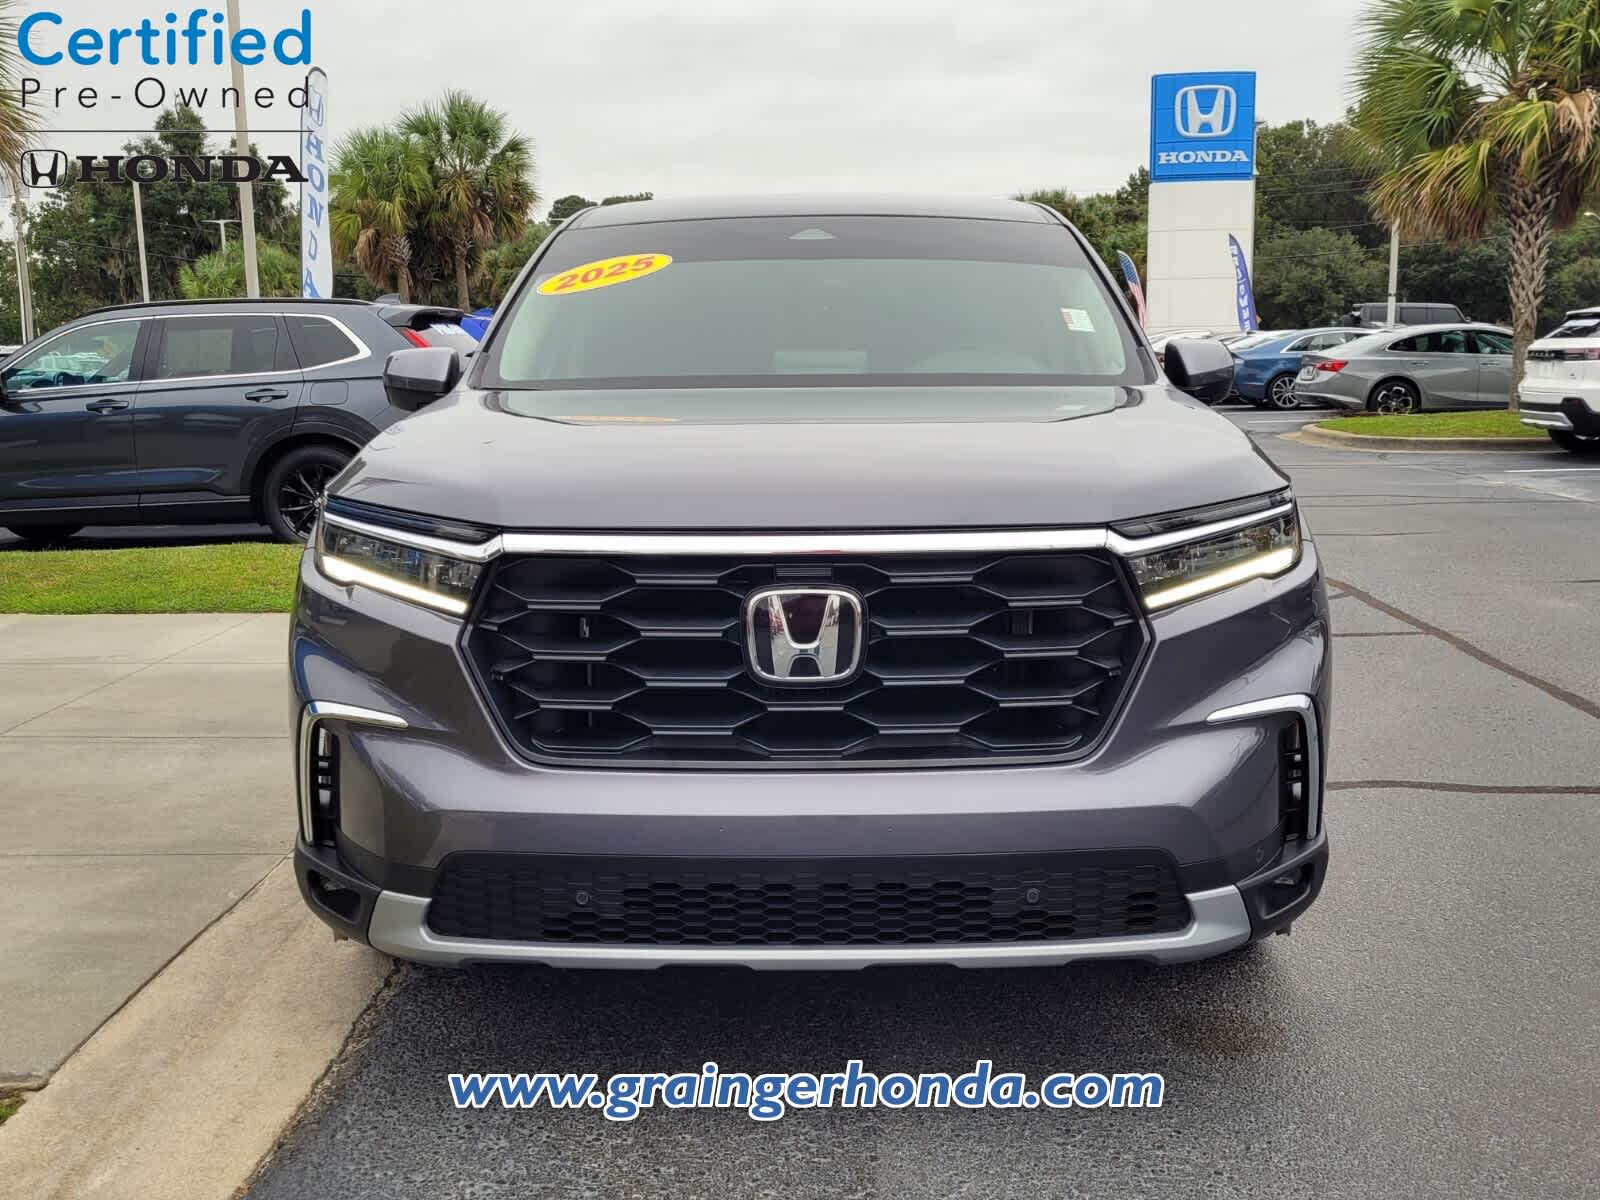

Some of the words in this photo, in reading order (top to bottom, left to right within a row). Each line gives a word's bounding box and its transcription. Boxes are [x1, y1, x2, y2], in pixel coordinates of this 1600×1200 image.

[1158, 150, 1249, 164] HONDA
[304, 126, 326, 298] HONDA
[554, 256, 655, 291] 2025
